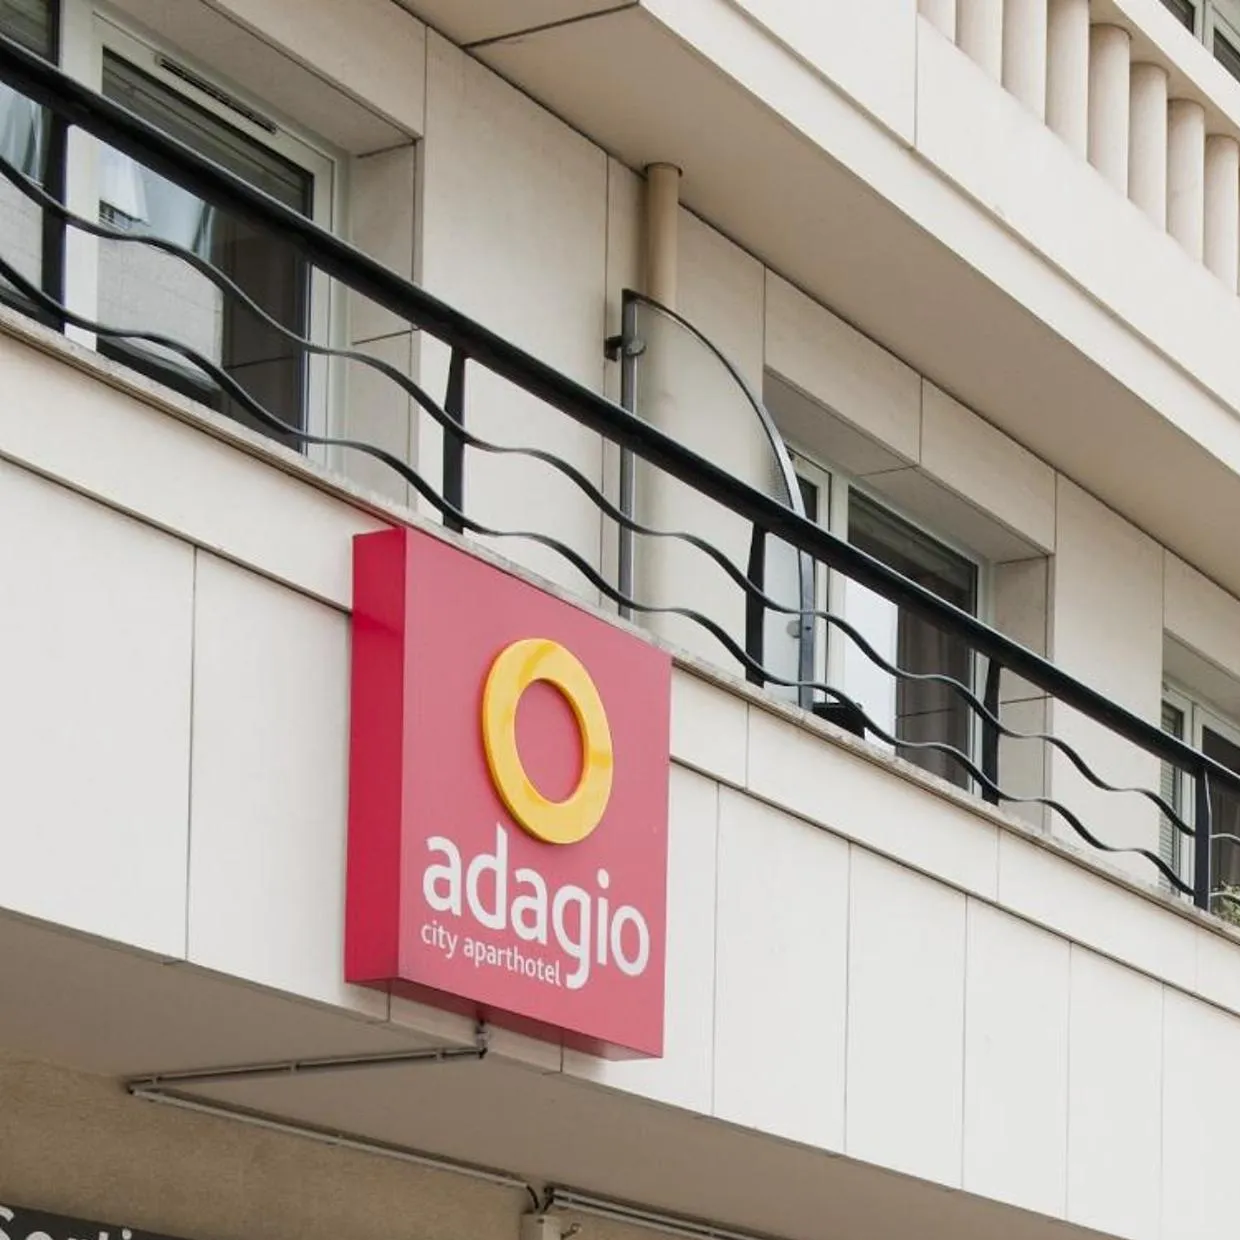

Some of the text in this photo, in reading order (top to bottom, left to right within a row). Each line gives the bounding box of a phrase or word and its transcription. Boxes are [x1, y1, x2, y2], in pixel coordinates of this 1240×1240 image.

[421, 920, 562, 986] city aparthotel
[423, 823, 649, 989] adagio
